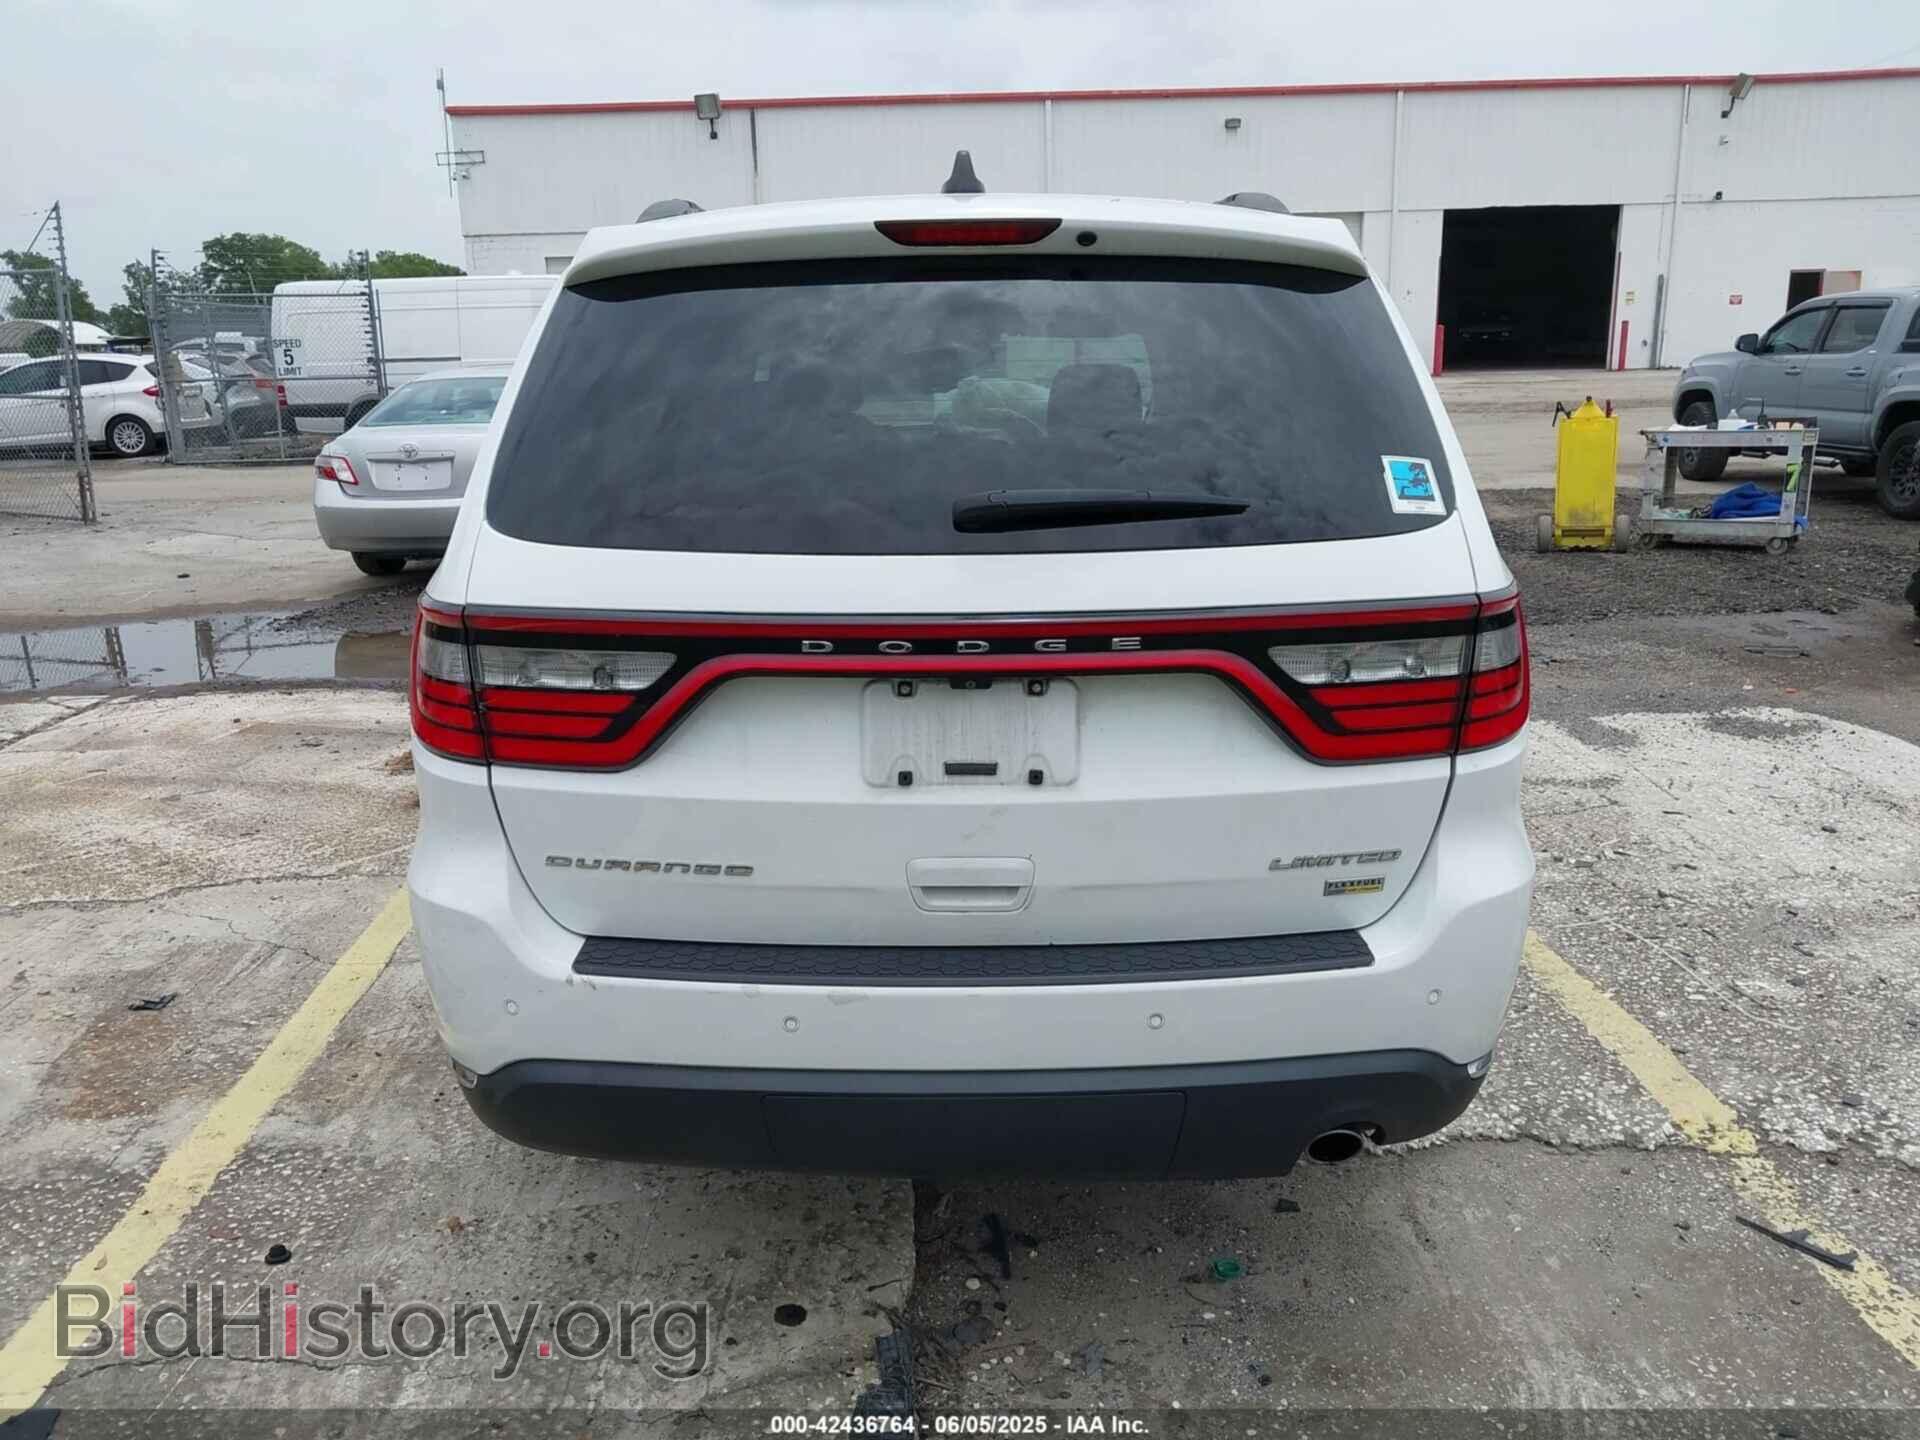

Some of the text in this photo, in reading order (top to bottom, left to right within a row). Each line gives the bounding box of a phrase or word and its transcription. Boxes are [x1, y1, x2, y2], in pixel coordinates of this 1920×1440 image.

[272, 338, 302, 349] SPEED
[283, 349, 294, 366] 5
[278, 366, 303, 377] LIMIT
[801, 636, 1143, 654] DODGE
[544, 855, 755, 877] DURANGO
[1268, 849, 1403, 871] LIMITED
